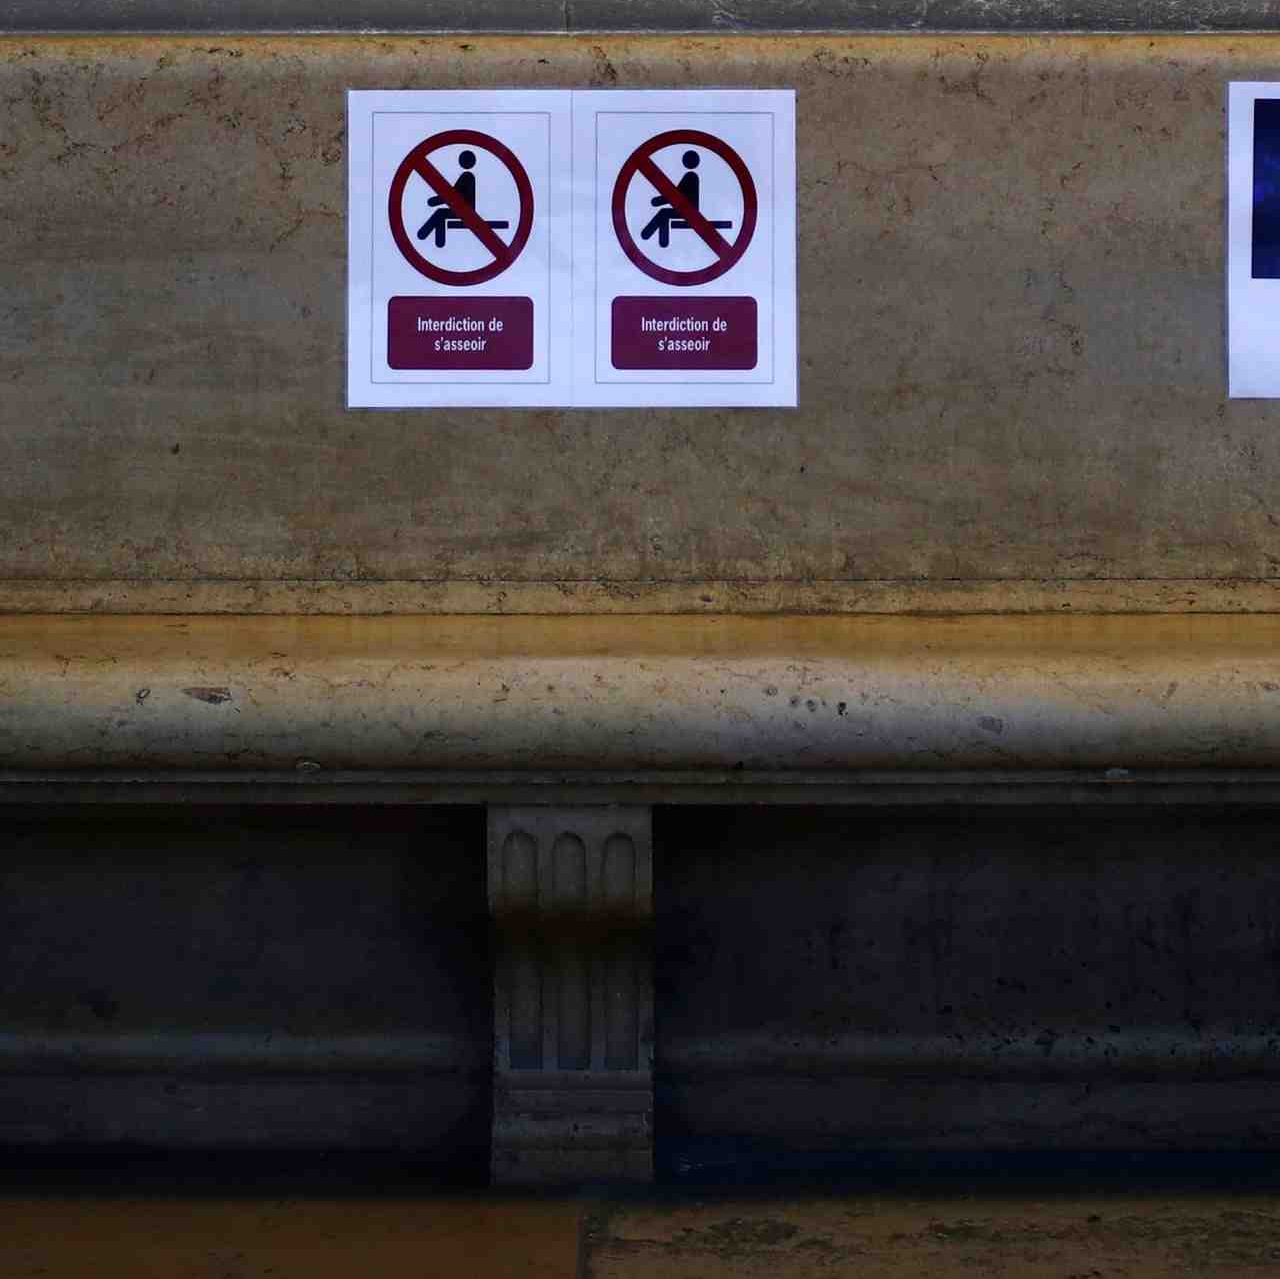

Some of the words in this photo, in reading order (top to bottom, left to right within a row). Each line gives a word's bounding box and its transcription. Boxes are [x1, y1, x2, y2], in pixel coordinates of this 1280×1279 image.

[417, 316, 485, 332] Interdiction
[488, 316, 504, 332] de
[641, 316, 709, 332] Interdiction
[712, 316, 728, 332] de
[434, 336, 487, 351] s'asseoir
[658, 336, 711, 351] s'asseoir
